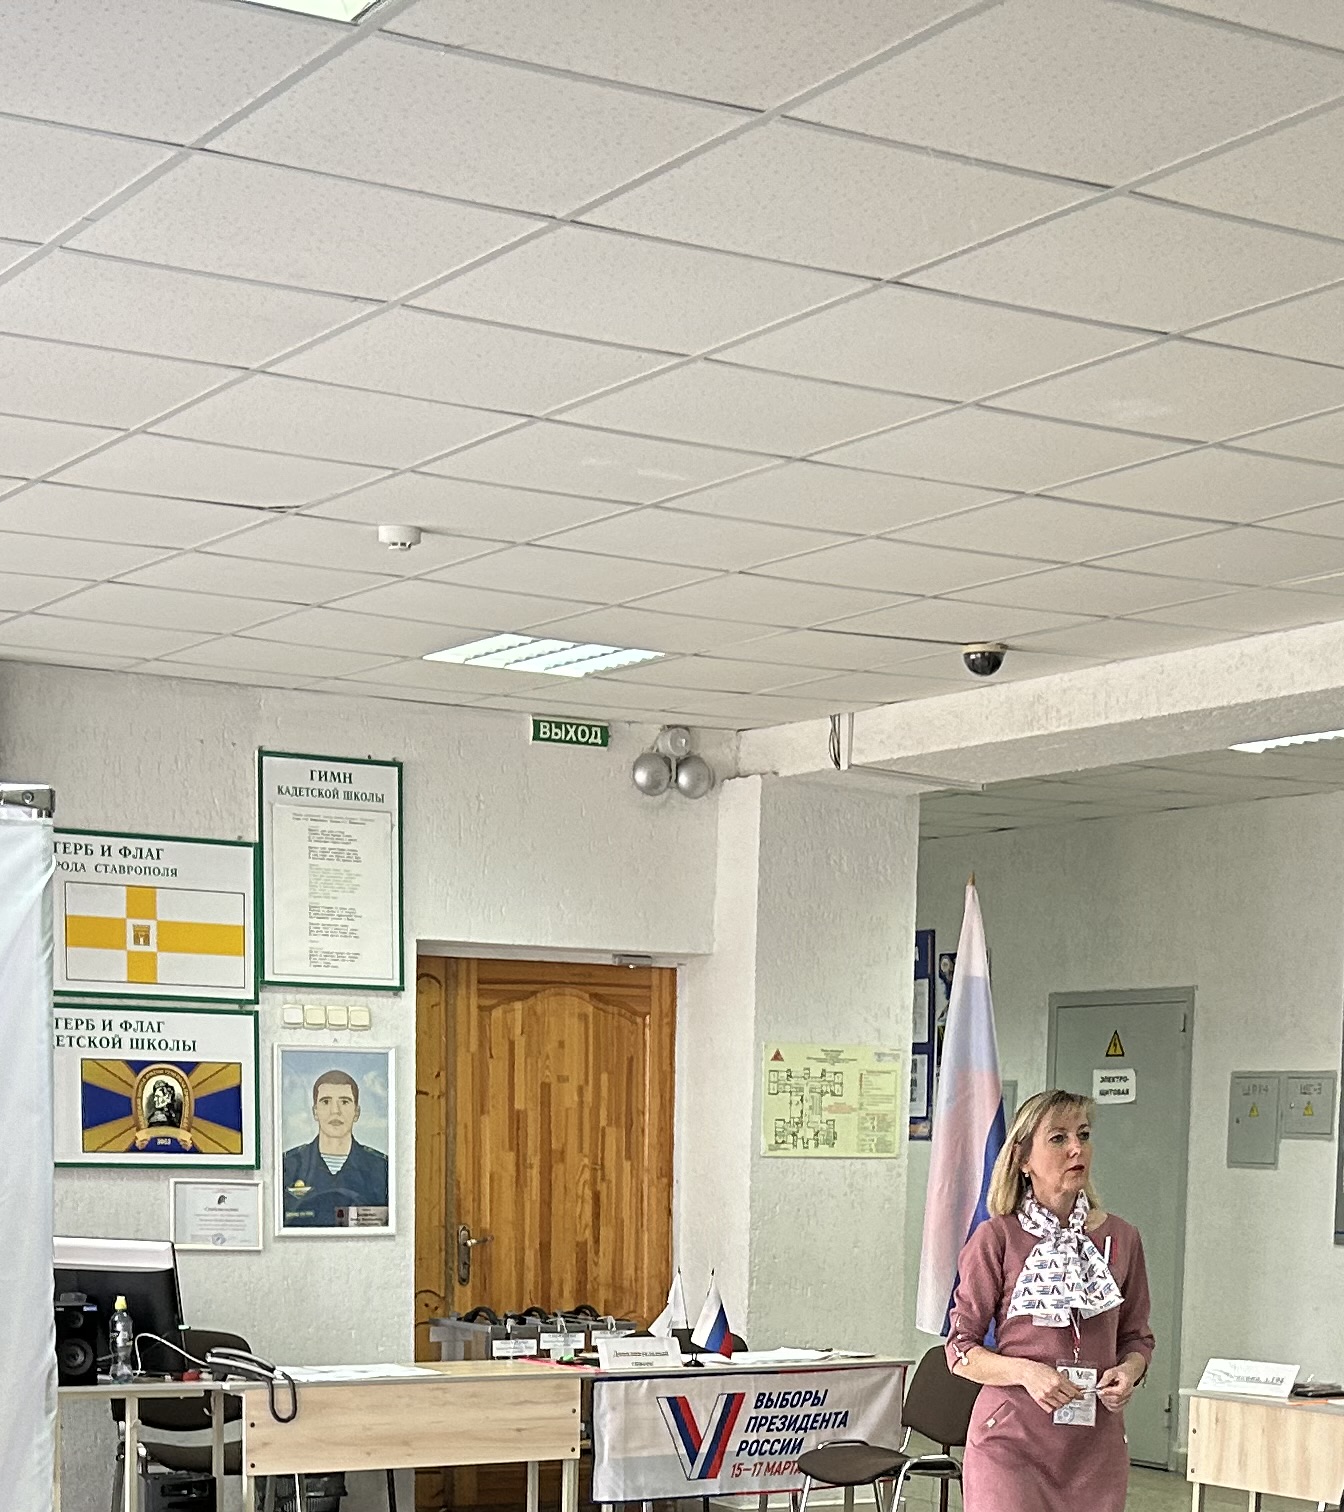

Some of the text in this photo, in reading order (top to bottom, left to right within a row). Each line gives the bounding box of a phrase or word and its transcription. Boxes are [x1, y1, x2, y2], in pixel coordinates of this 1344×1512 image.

[539, 722, 602, 745] ВЫХОД
[309, 769, 353, 784] ГИМН
[277, 785, 385, 803] КАДЕТСКОЙ ШКОЛЫ
[53, 841, 164, 860] ГЕРБ И ФЛАГ
[94, 863, 178, 878] СТАВРОПОЛЯ
[54, 1017, 165, 1033] ГЕРБ И ФЛАГ
[55, 1034, 197, 1052] ЕТСКОЙ ШКОЛЫ
[754, 1389, 829, 1410] ВЫБОРЫ
[744, 1410, 850, 1434] ПРЕЗИДЕНТА
[736, 1437, 805, 1457] РОССИИ
